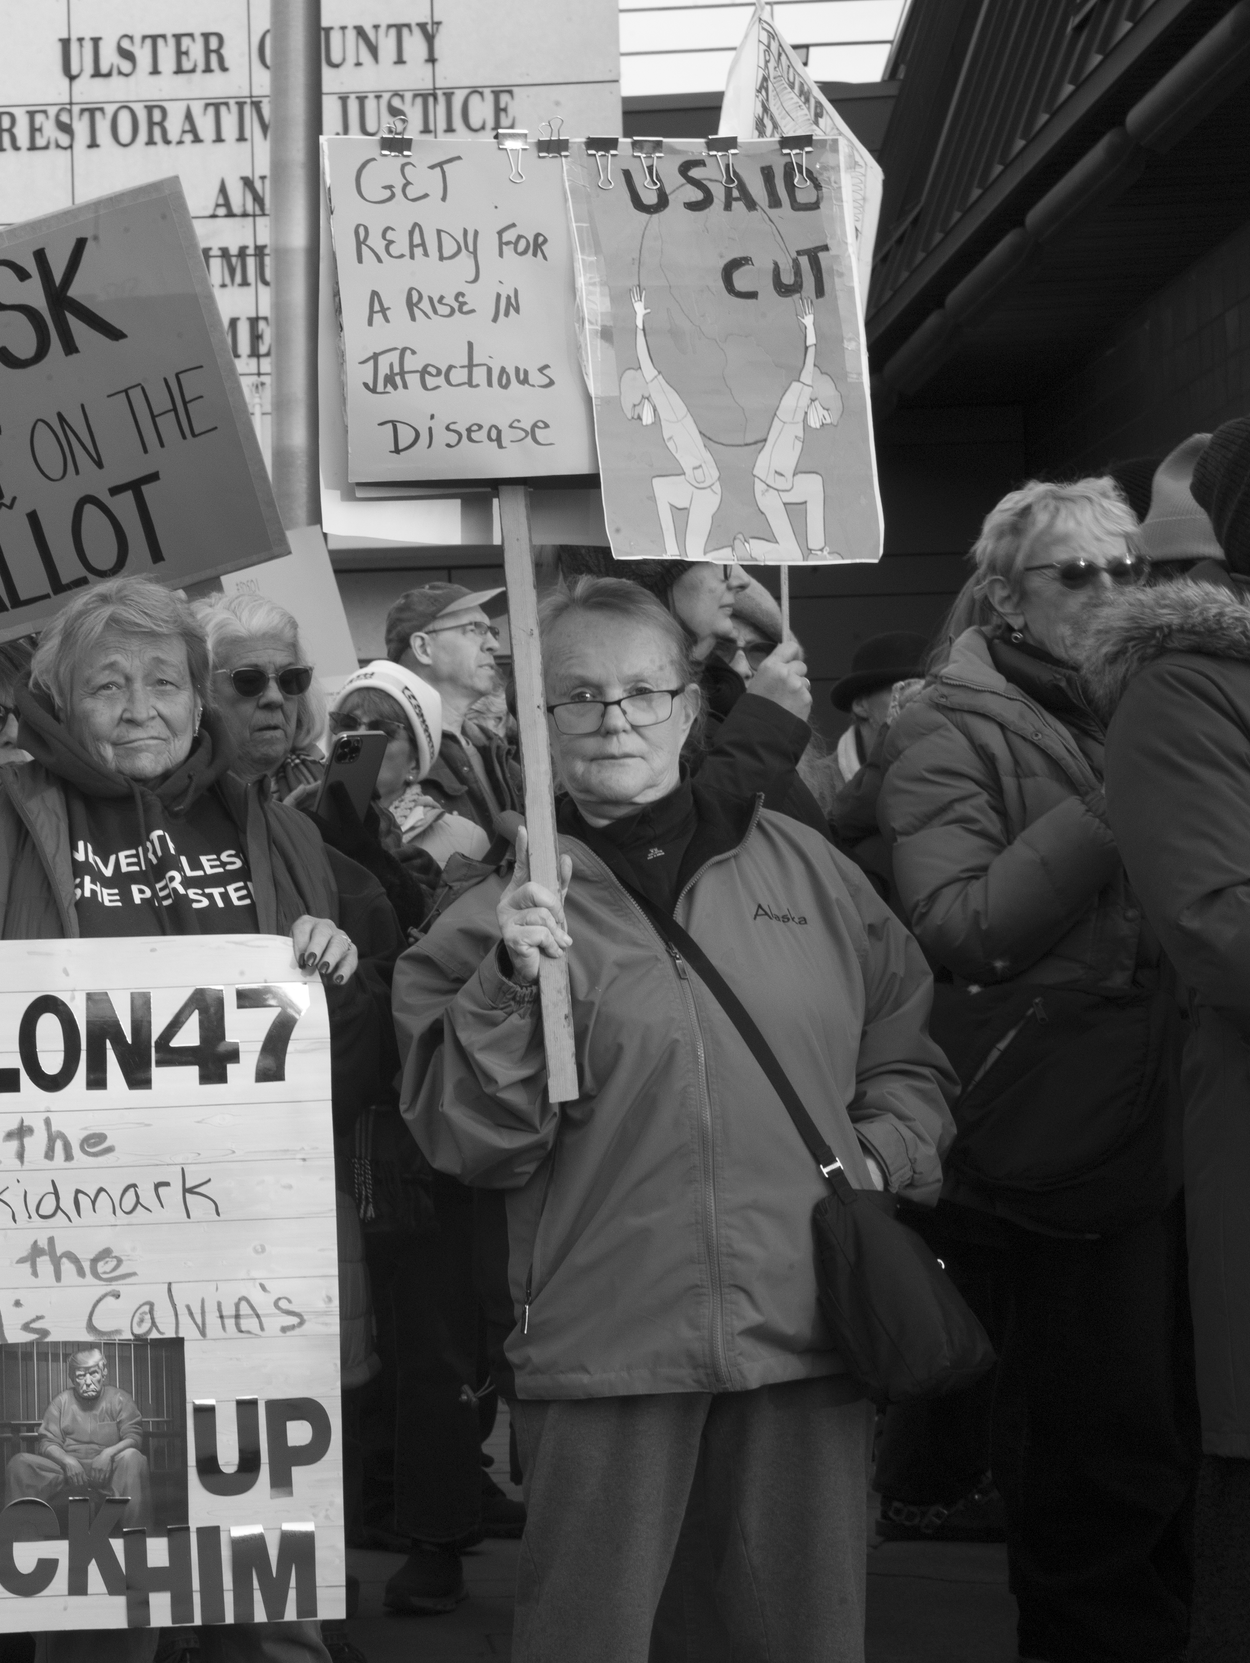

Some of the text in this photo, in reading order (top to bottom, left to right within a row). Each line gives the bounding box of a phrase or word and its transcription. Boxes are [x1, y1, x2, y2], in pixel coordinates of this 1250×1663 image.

[58, 20, 443, 79] ULSTER UNTY
[334, 88, 517, 137] JUSTICE
[209, 175, 267, 217] AN
[355, 155, 463, 204] GET
[621, 158, 823, 215] USAID
[354, 222, 548, 284] READY FOR
[367, 289, 391, 327] A
[405, 286, 477, 322] RISE
[30, 403, 104, 483] ON
[106, 364, 218, 454] THE
[377, 413, 556, 455] Disease
[753, 903, 808, 925] Alaska
[3, 1116, 116, 1168] the
[15, 1235, 138, 1283] the
[192, 1396, 332, 1500] UP
[122, 1521, 318, 1628] HIM
